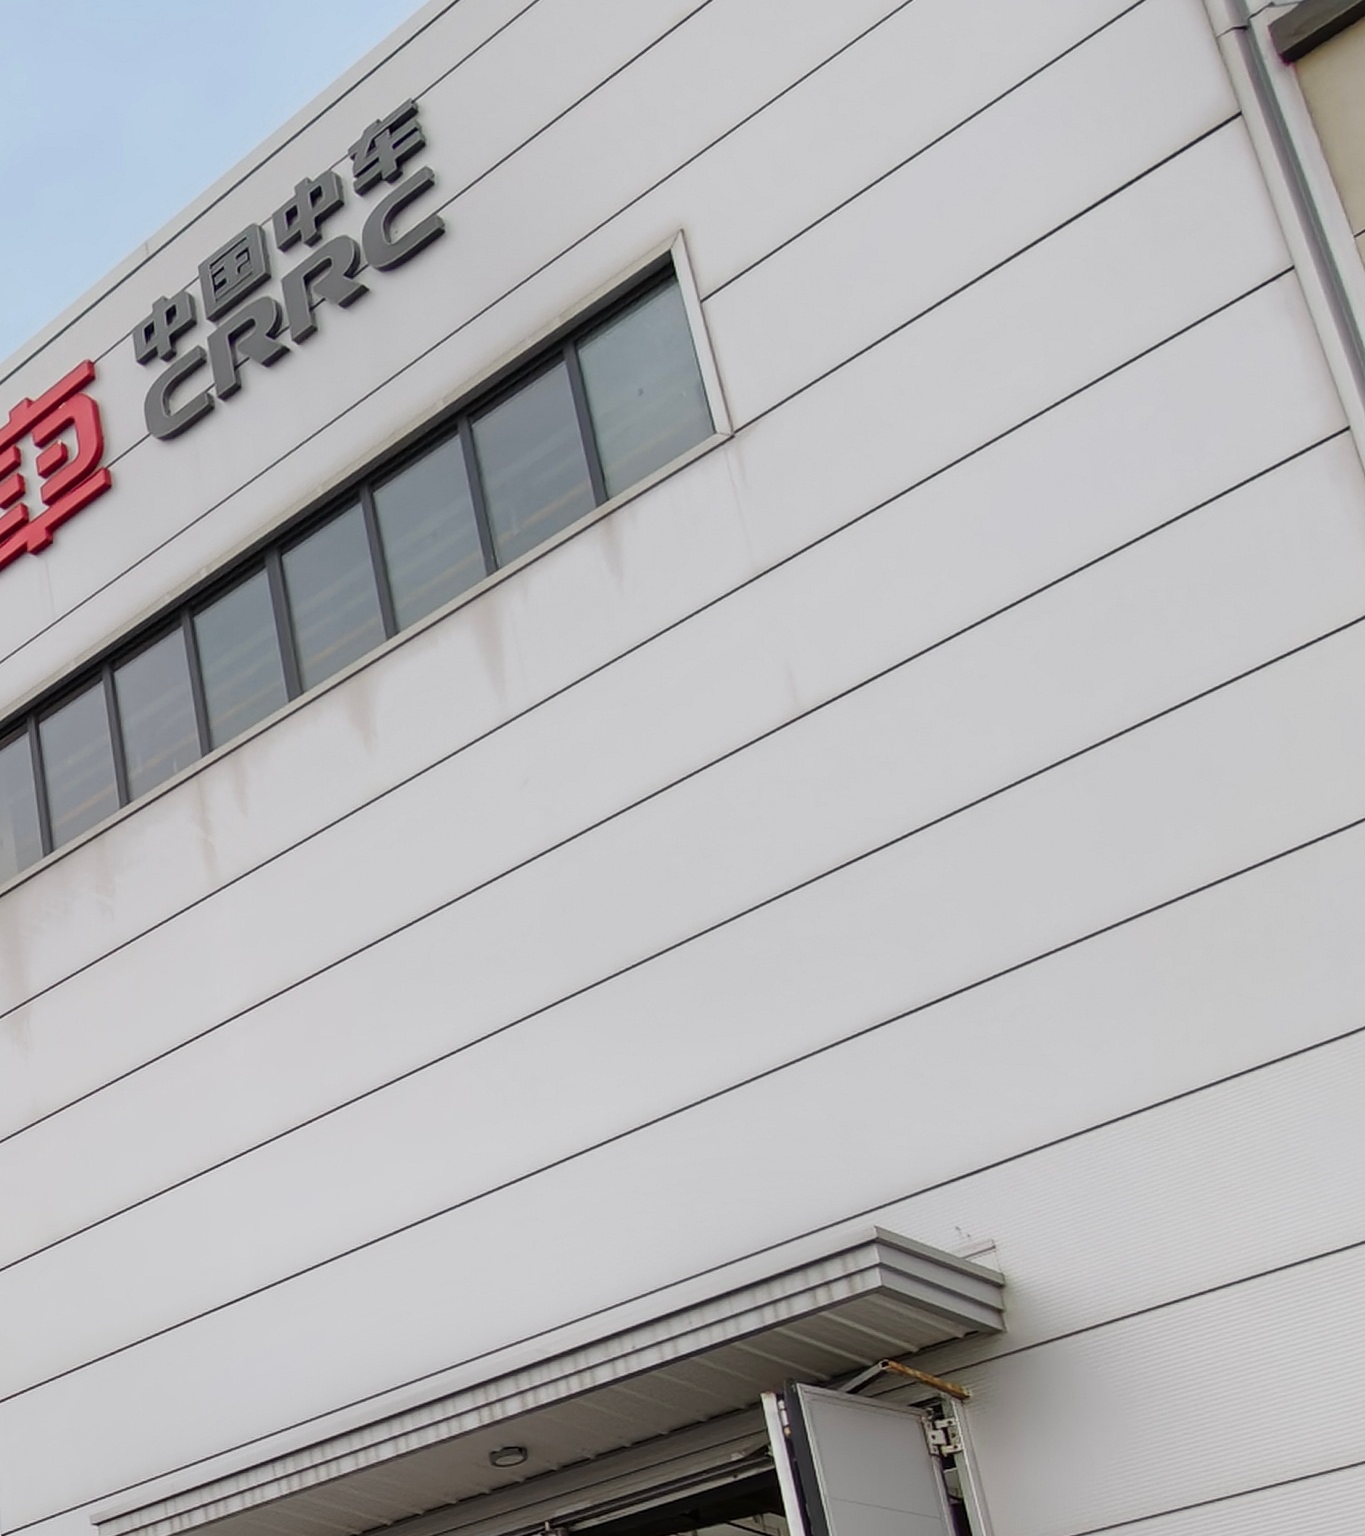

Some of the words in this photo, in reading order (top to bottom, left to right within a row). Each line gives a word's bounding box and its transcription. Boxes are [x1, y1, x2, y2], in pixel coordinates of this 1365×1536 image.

[131, 98, 426, 365] 中国中车
[143, 166, 446, 441] CRRC
